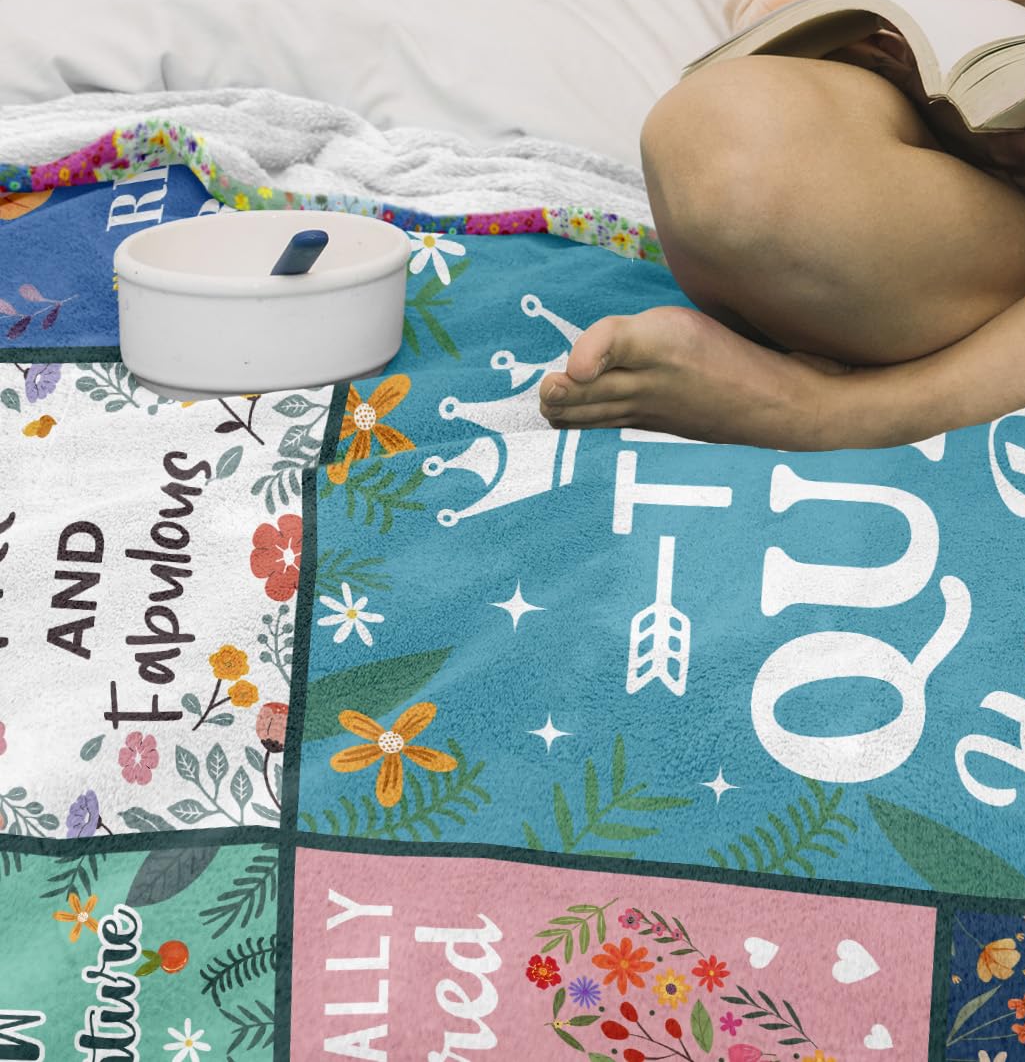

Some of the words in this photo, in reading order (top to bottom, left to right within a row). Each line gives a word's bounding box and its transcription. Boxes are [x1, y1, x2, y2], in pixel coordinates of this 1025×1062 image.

[46, 520, 105, 660] AND
[103, 450, 212, 730] Fabulous
[76, 905, 140, 1062] ture
